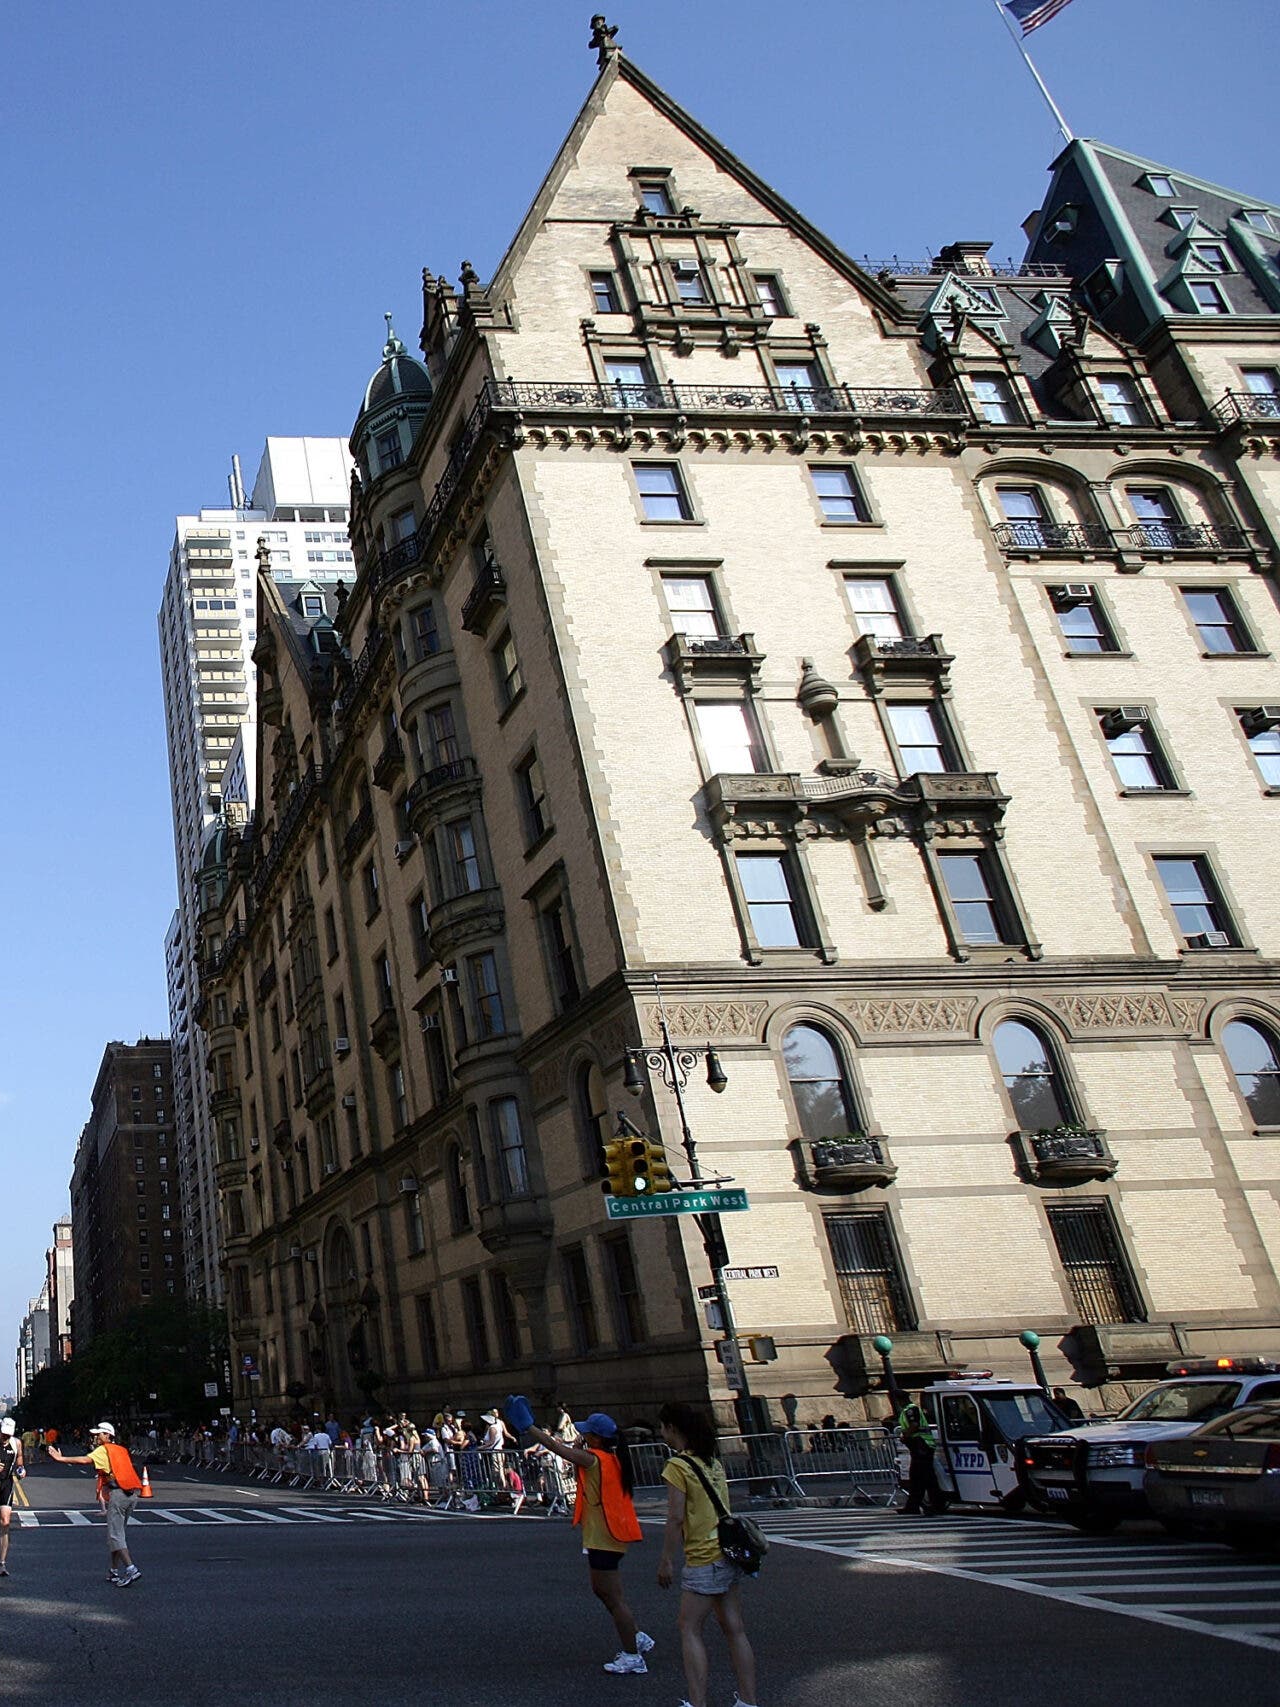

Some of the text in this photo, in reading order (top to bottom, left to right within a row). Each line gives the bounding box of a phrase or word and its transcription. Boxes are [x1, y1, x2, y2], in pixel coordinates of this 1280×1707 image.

[611, 1194, 746, 1213] Central Park West
[955, 1453, 984, 1468] NYPD
